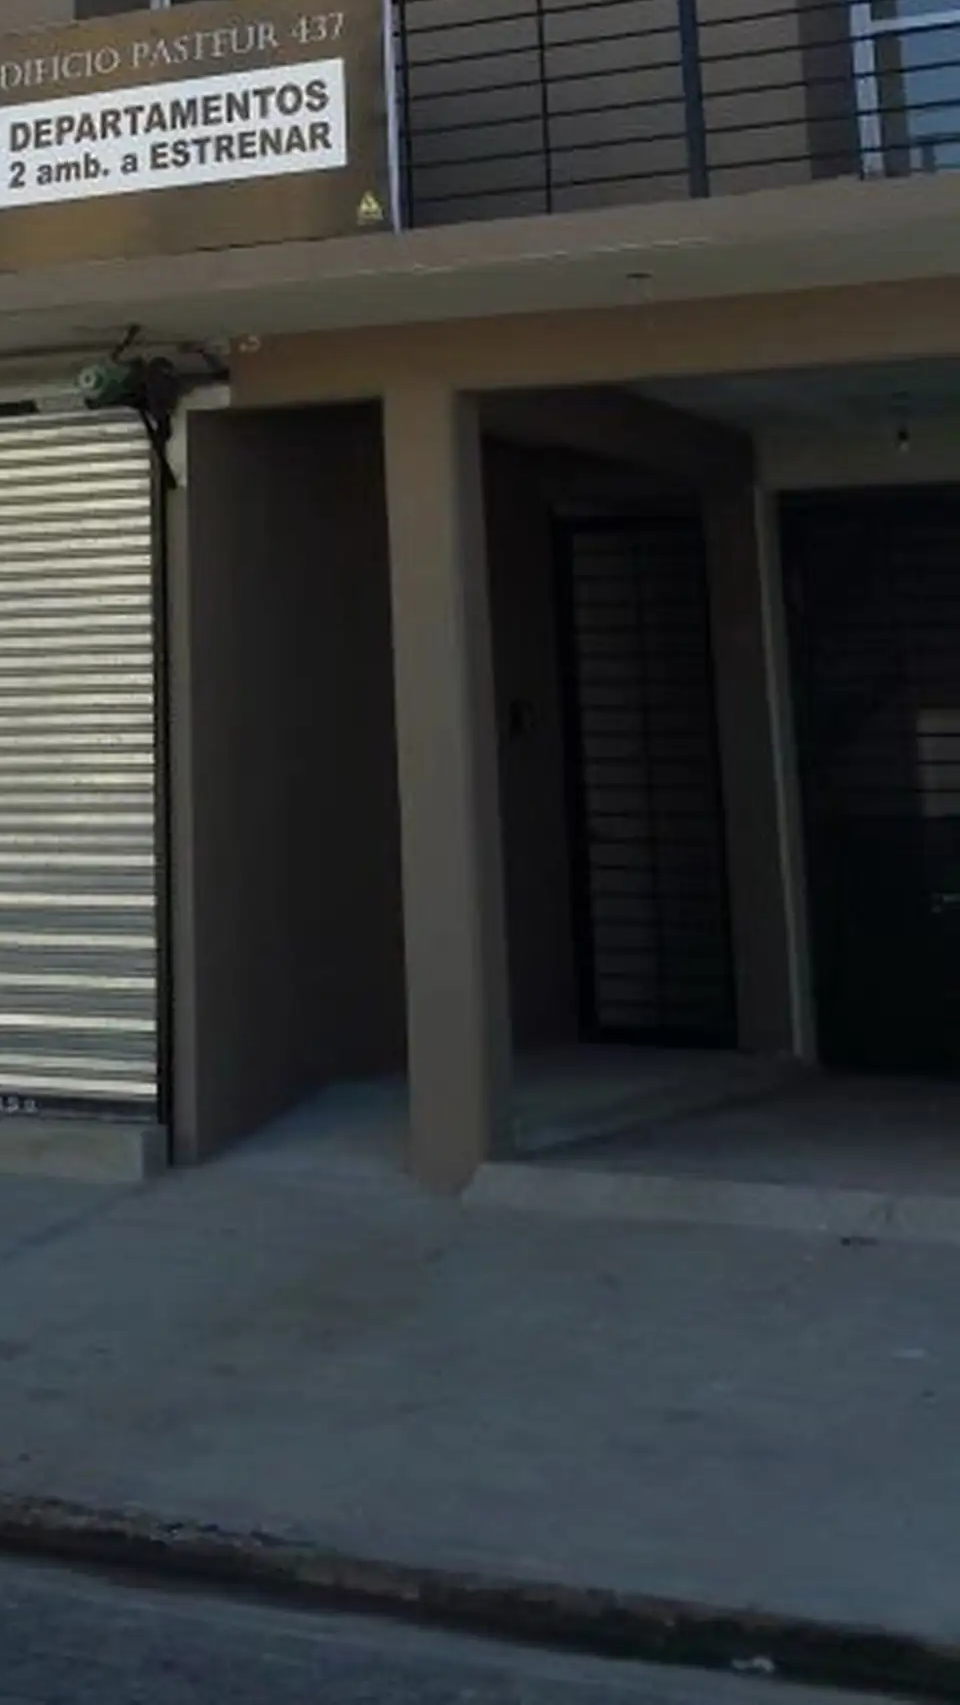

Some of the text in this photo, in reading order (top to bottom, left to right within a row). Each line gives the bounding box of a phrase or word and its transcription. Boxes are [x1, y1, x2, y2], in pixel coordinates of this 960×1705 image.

[132, 20, 278, 67] PASTEUR
[291, 12, 344, 44] 437
[9, 80, 328, 152] DEPARTAMENTOS
[8, 121, 333, 189] 2 amb. a ESTRENAR
